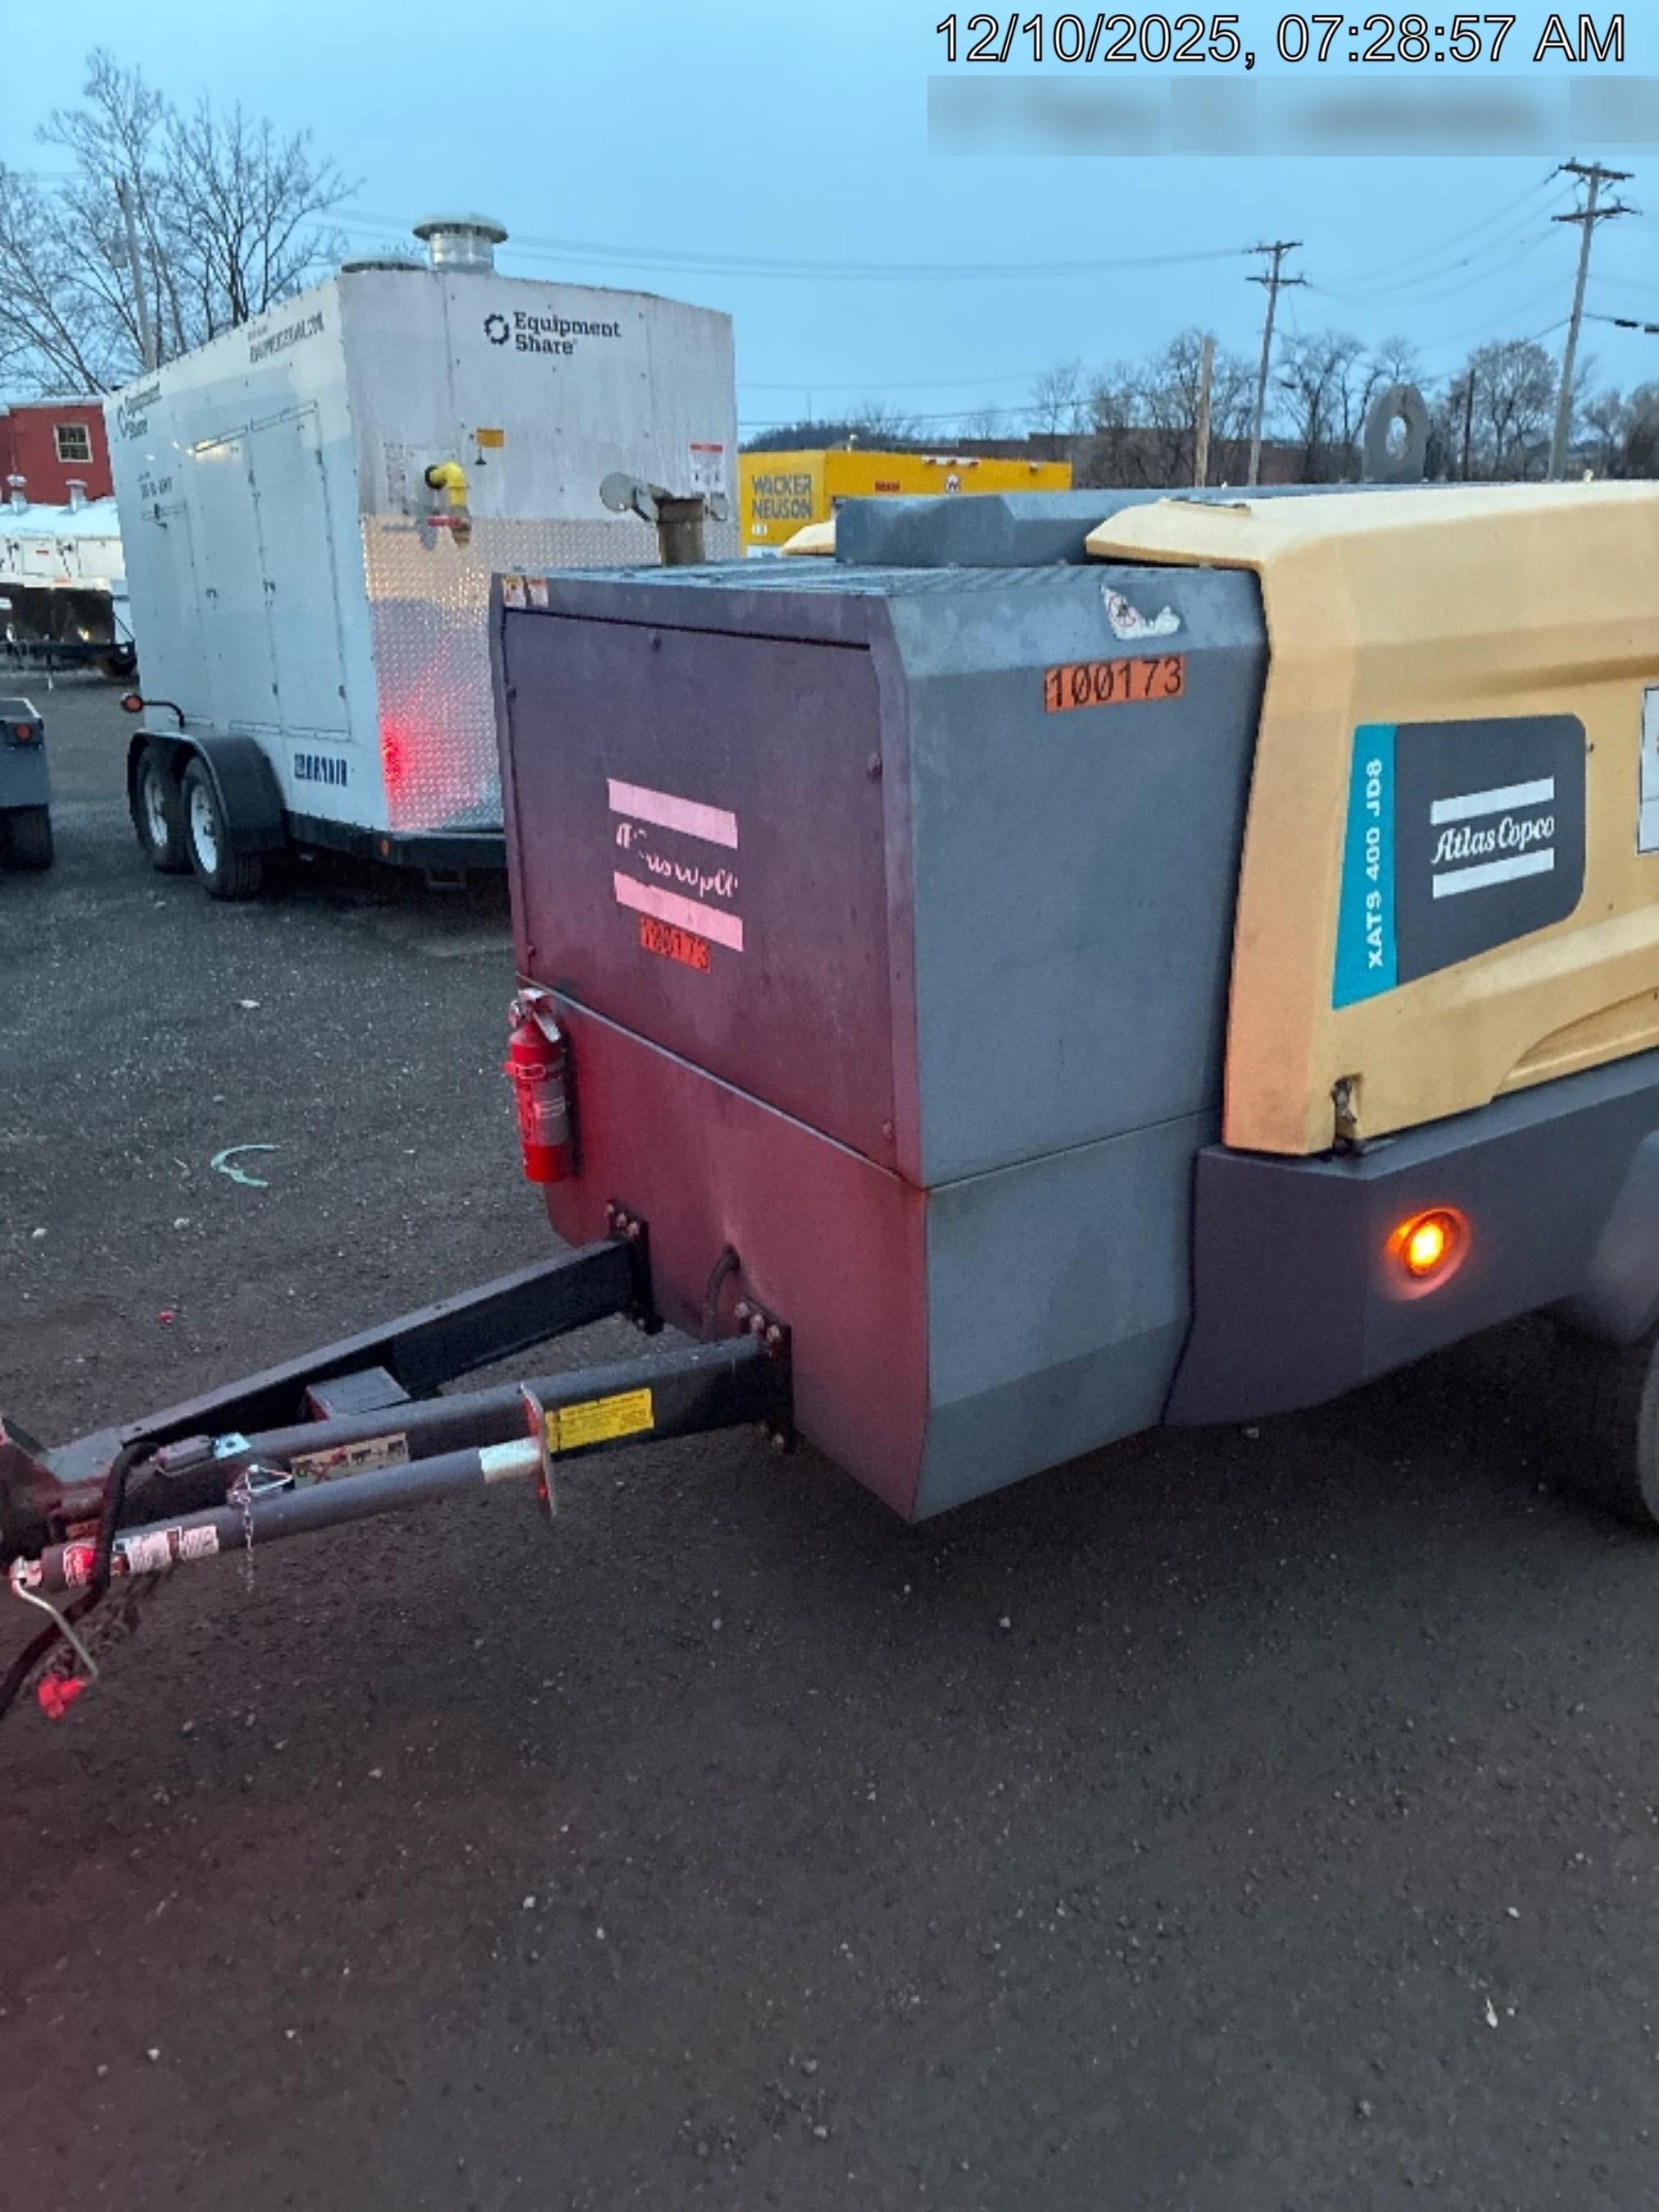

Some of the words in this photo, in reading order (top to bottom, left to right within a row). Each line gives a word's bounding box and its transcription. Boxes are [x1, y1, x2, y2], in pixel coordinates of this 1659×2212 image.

[513, 311, 623, 338] Equipment
[514, 333, 574, 355] Share
[751, 474, 812, 495] WACKER
[751, 497, 812, 519] NEUSON
[1050, 656, 1181, 708] 100173
[1366, 758, 1384, 818] JD8
[1366, 827, 1381, 882] 400
[1430, 825, 1496, 866] Atlas
[1498, 815, 1555, 851] Copco
[1366, 888, 1384, 970] XATS
